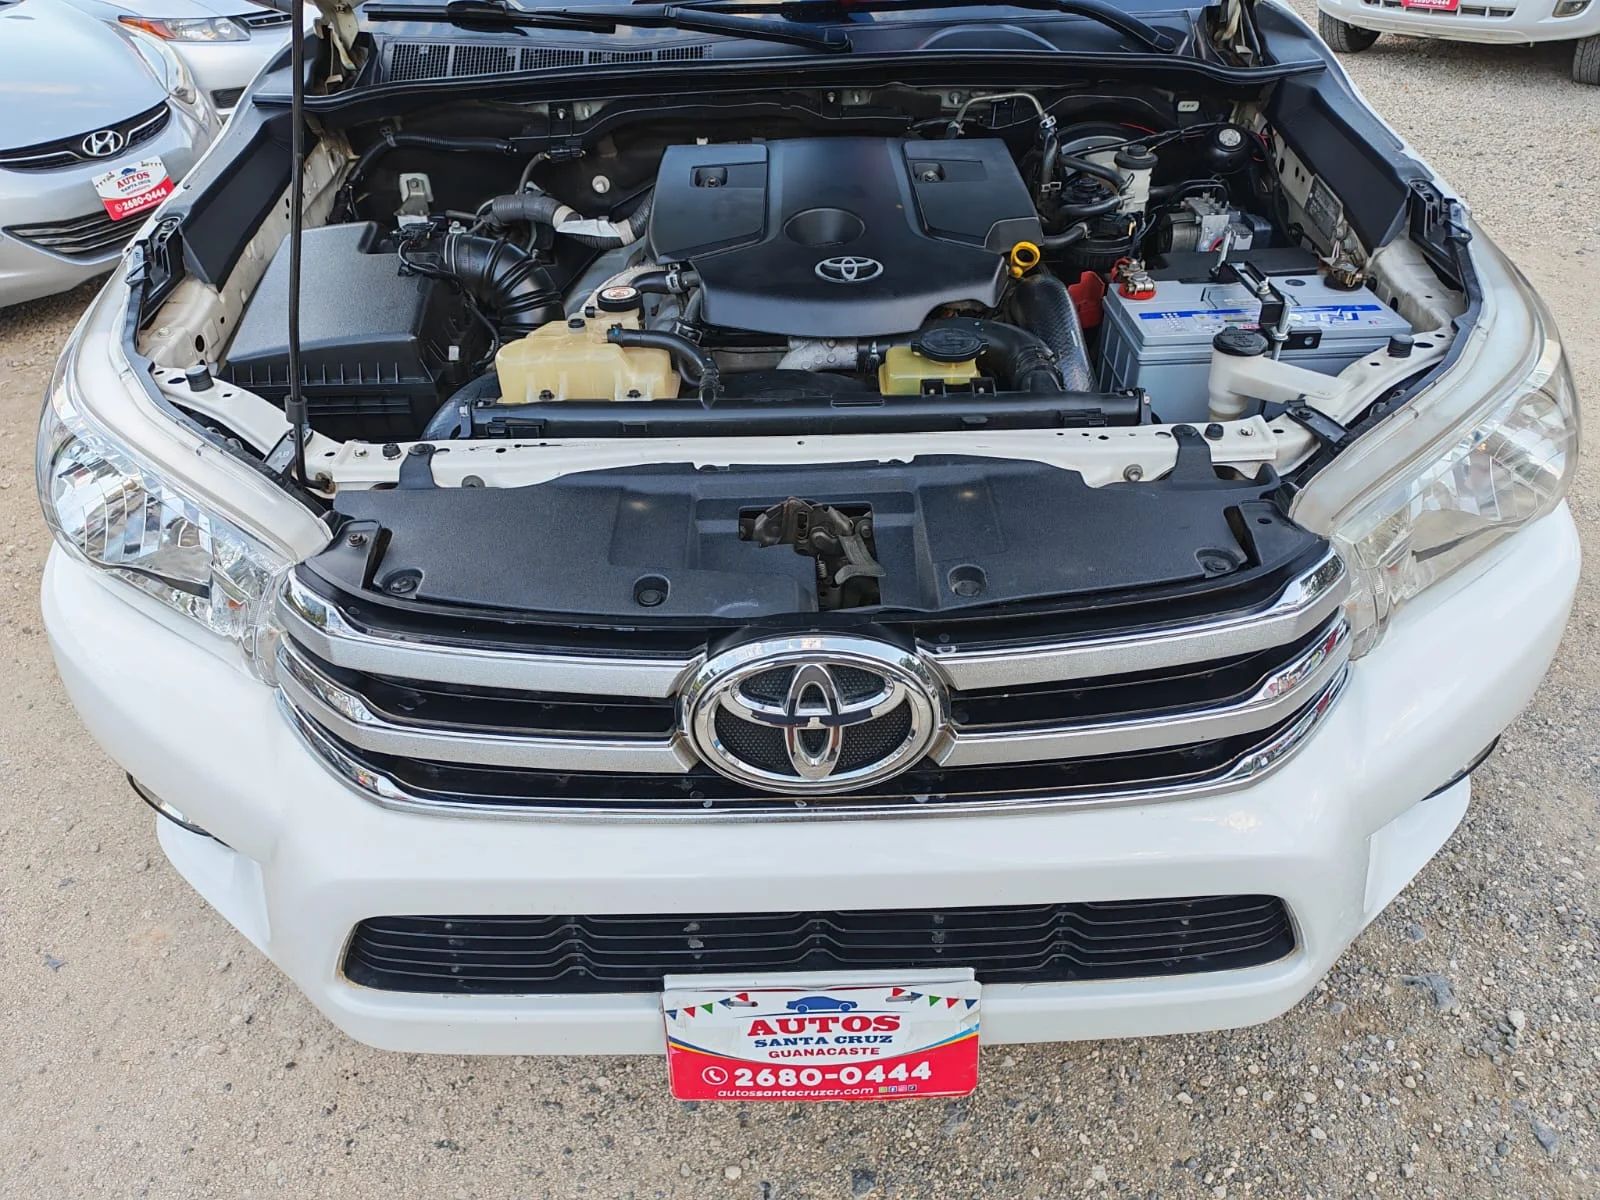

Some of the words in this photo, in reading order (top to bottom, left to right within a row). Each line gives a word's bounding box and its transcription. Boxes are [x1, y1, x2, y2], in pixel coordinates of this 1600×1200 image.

[117, 172, 150, 188] AUTOS
[122, 187, 166, 210] 2680-0444
[747, 1015, 900, 1036] AUTOS
[754, 1036, 829, 1048] SANTA
[834, 1035, 893, 1044] CRUZ
[768, 1047, 881, 1059] GUANACASTE
[733, 1061, 932, 1087] 2680-0444
[717, 1086, 874, 1098] autossantacruzcr.com
